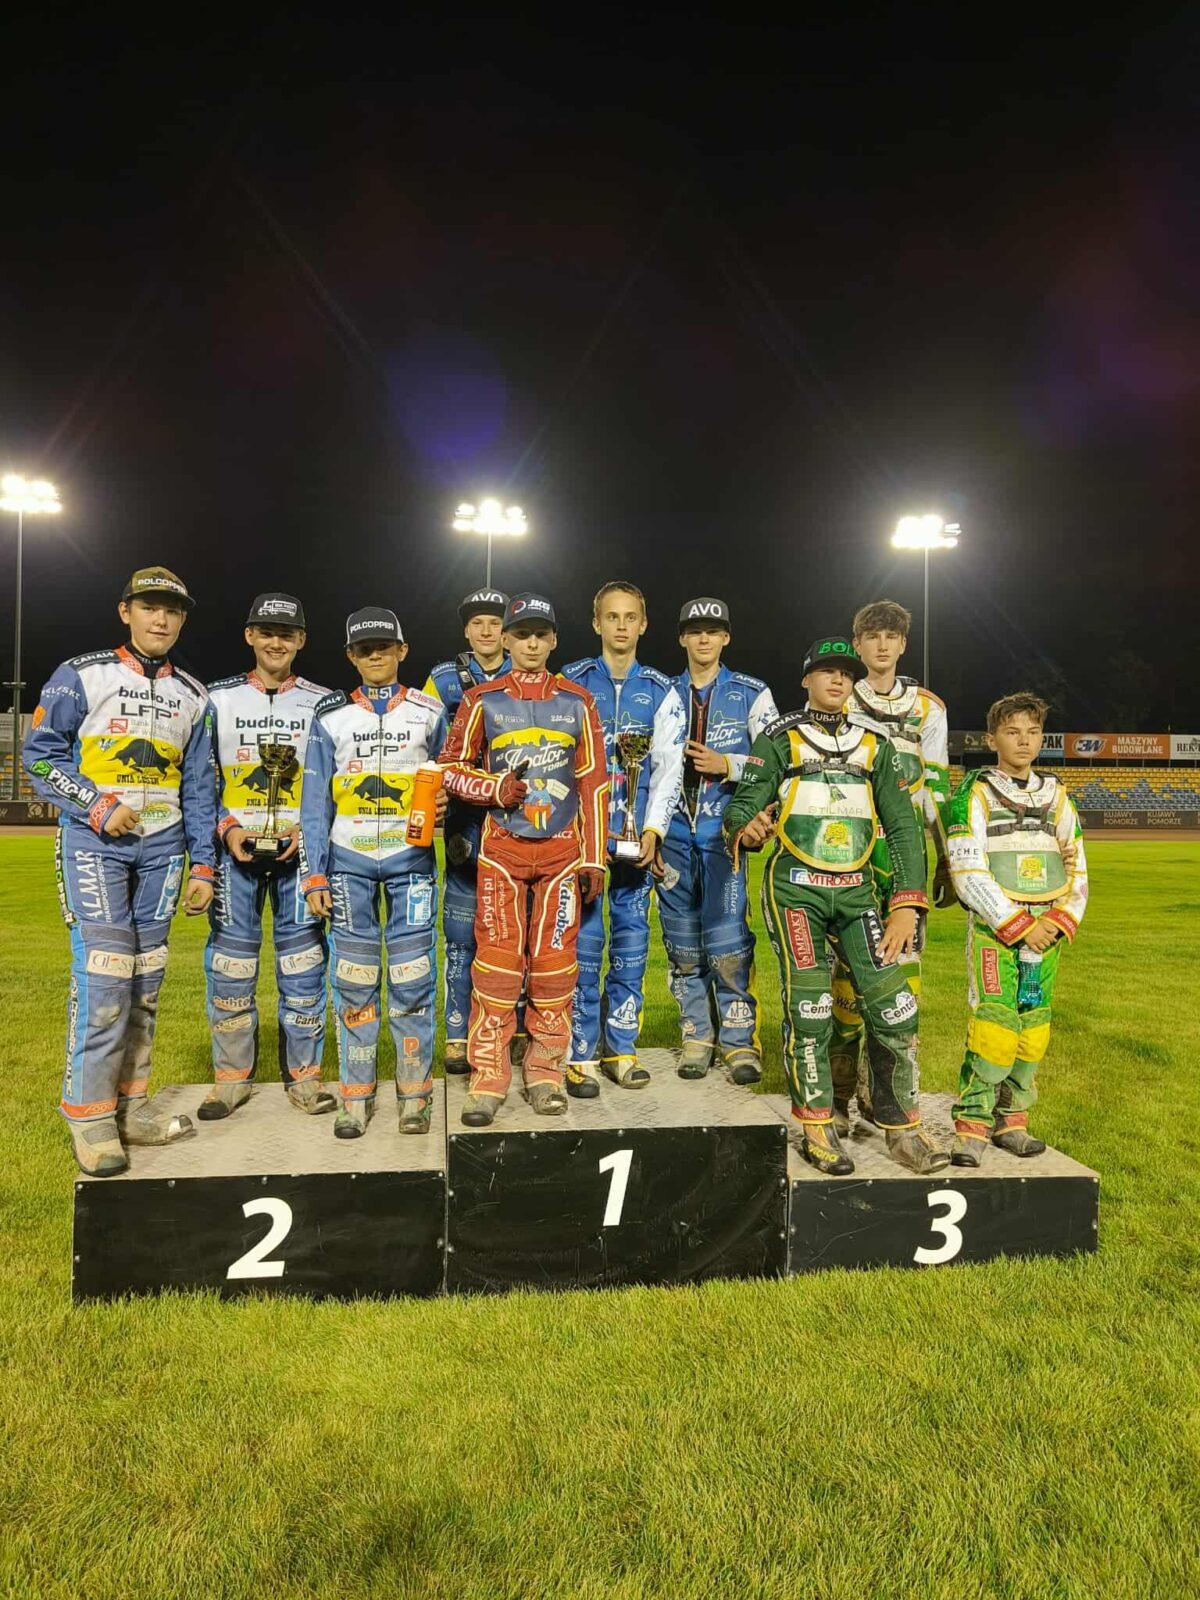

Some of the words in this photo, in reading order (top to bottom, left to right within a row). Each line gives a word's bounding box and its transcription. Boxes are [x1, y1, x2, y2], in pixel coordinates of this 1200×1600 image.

[688, 602, 722, 618] AVO
[350, 620, 394, 634] POLCOPPER
[735, 674, 765, 688] APRO
[118, 685, 181, 711] budio.pl
[379, 686, 392, 699] 51
[120, 702, 172, 719] LFP
[236, 715, 305, 731] budio.pl
[764, 711, 804, 739] CANAL+
[240, 731, 293, 747] LFP
[353, 730, 411, 743] budio.pl
[1117, 736, 1158, 745] MASZYNY
[356, 744, 400, 758] LFP
[1112, 744, 1164, 754] BUDOWLANE
[47, 767, 95, 804] PRO-M
[442, 770, 495, 798] BINGO
[74, 850, 104, 920] ALMAR
[598, 1149, 634, 1226] 1
[913, 1189, 968, 1265] 3
[226, 1197, 293, 1279] 2
